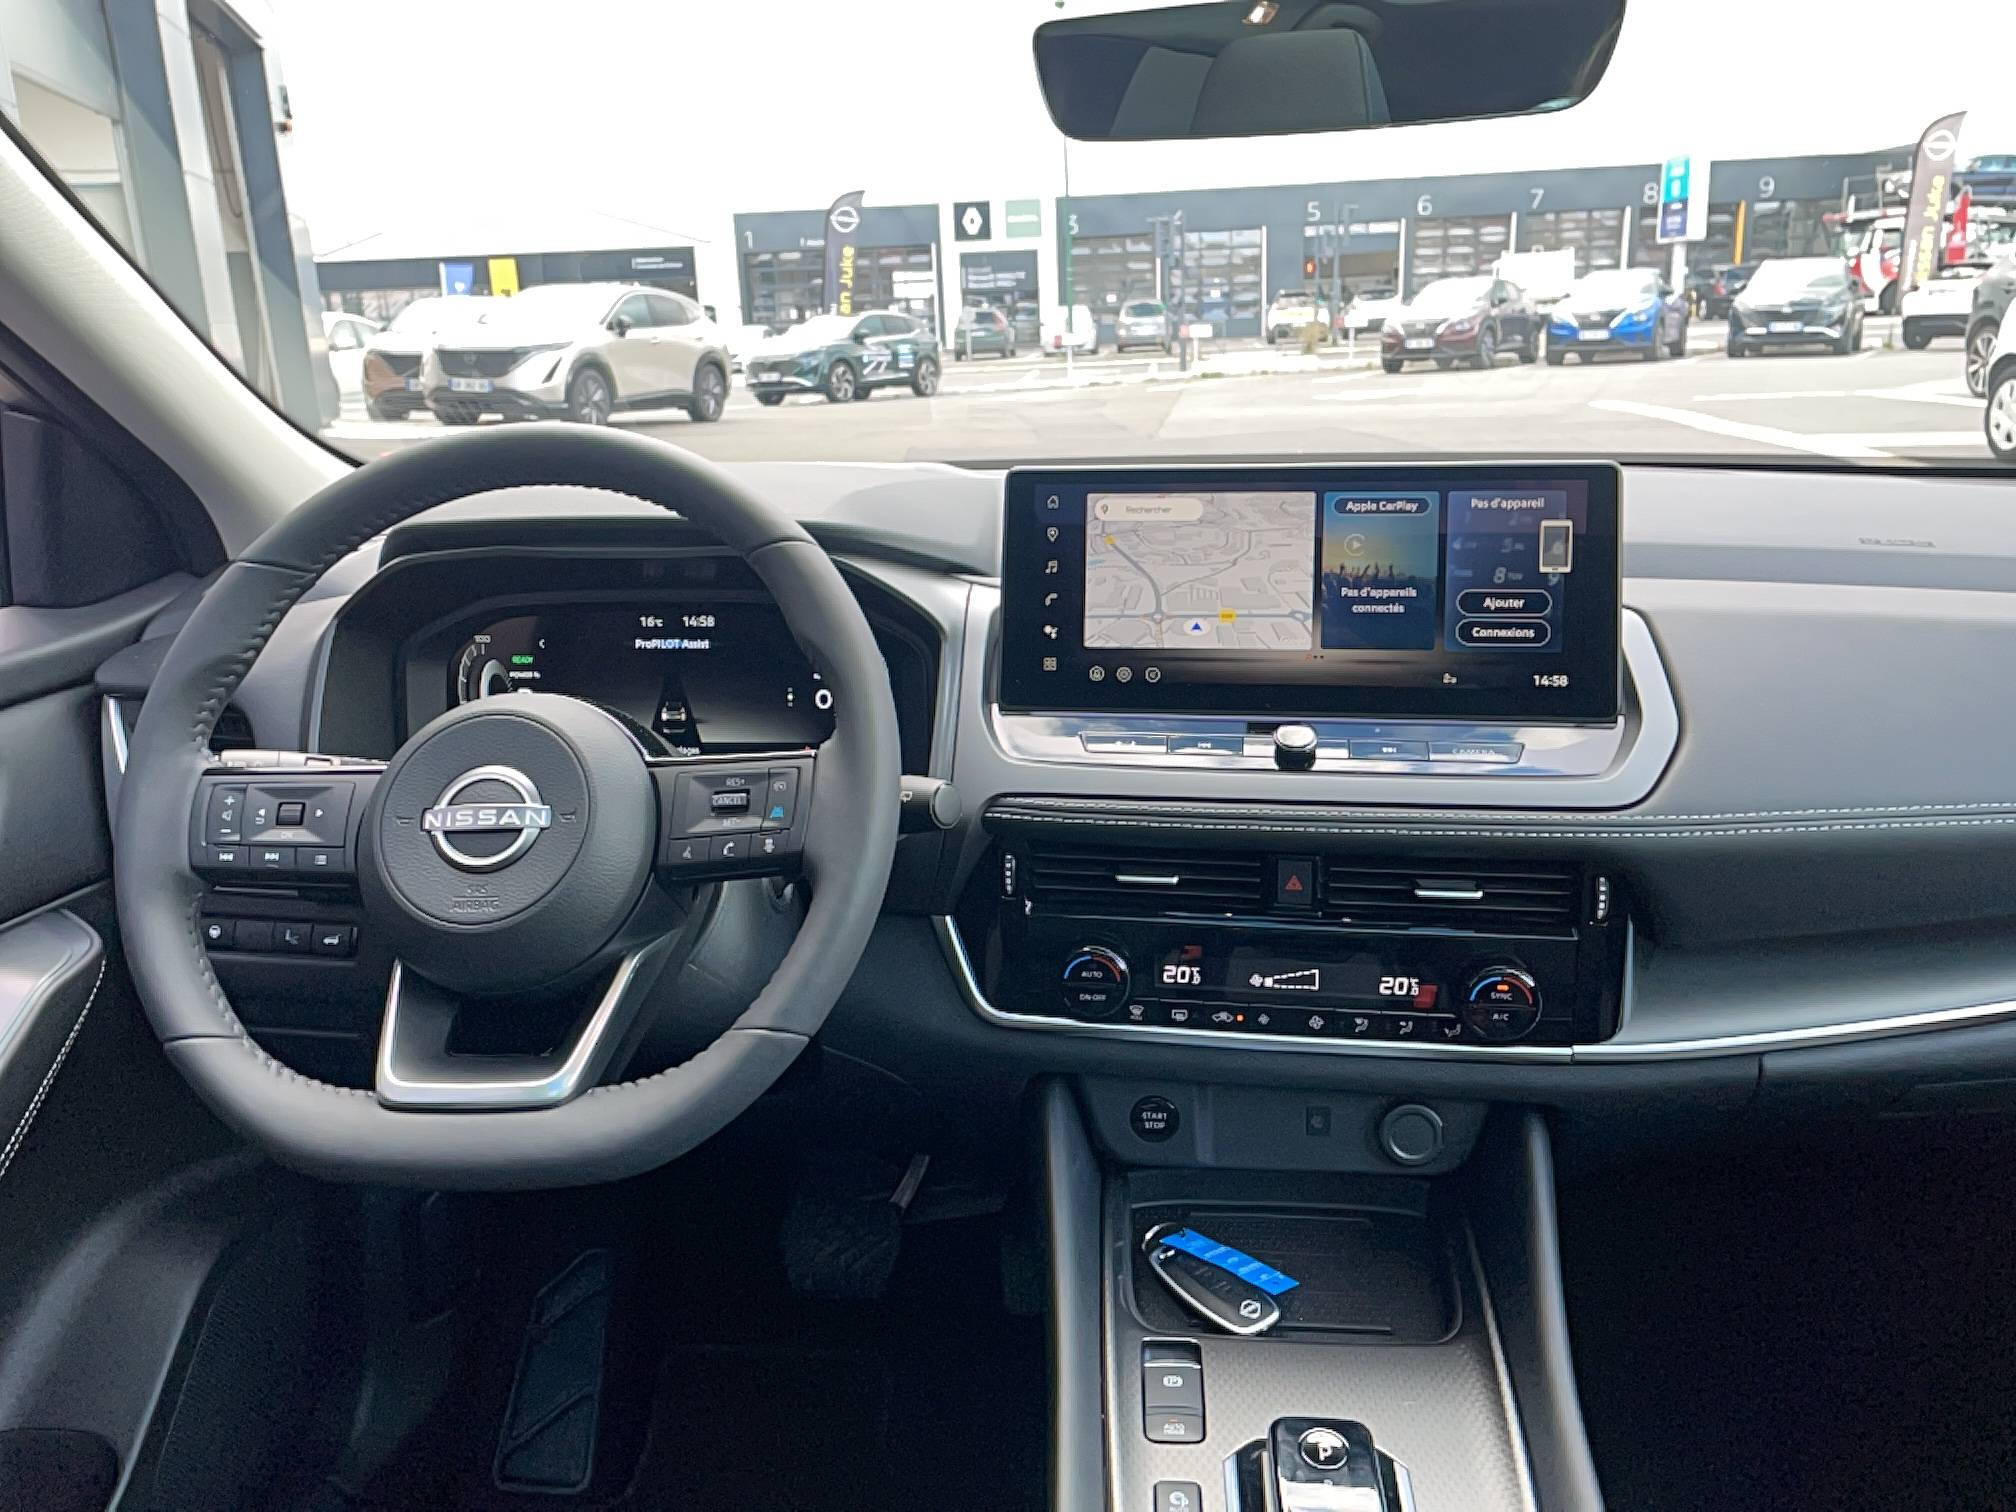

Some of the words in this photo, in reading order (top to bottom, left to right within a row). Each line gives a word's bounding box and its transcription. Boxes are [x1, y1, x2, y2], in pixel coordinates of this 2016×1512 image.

[1759, 176, 1775, 198] 9
[1530, 188, 1544, 209] 7
[1643, 182, 1658, 205] 8
[1307, 201, 1321, 221] 5
[1417, 195, 1433, 216] 6
[744, 230, 753, 249] 1
[839, 245, 855, 288] Juke
[1346, 501, 1377, 512] Apple
[1379, 501, 1418, 513] CarPlay
[1471, 498, 1489, 508] Pas
[1491, 497, 1545, 510] d'appareil
[1126, 506, 1172, 514] Rechercher
[1341, 587, 1359, 597] Pas
[1360, 587, 1418, 599] d'appareils
[1352, 602, 1406, 613] connectés
[1483, 597, 1526, 610] Ajouter
[682, 615, 716, 628] 14:58
[1472, 627, 1536, 638] Connexions
[635, 639, 681, 649] ProPILOT
[682, 639, 710, 649] Assist
[511, 655, 534, 664] READY
[1533, 675, 1569, 688] 14:58
[712, 797, 748, 806] CANCEL
[424, 809, 547, 830] NISSAN
[1081, 970, 1103, 978] AUTO
[1490, 992, 1512, 1001] SYNC
[1141, 1111, 1167, 1120] START
[1144, 1121, 1166, 1129] STOP
